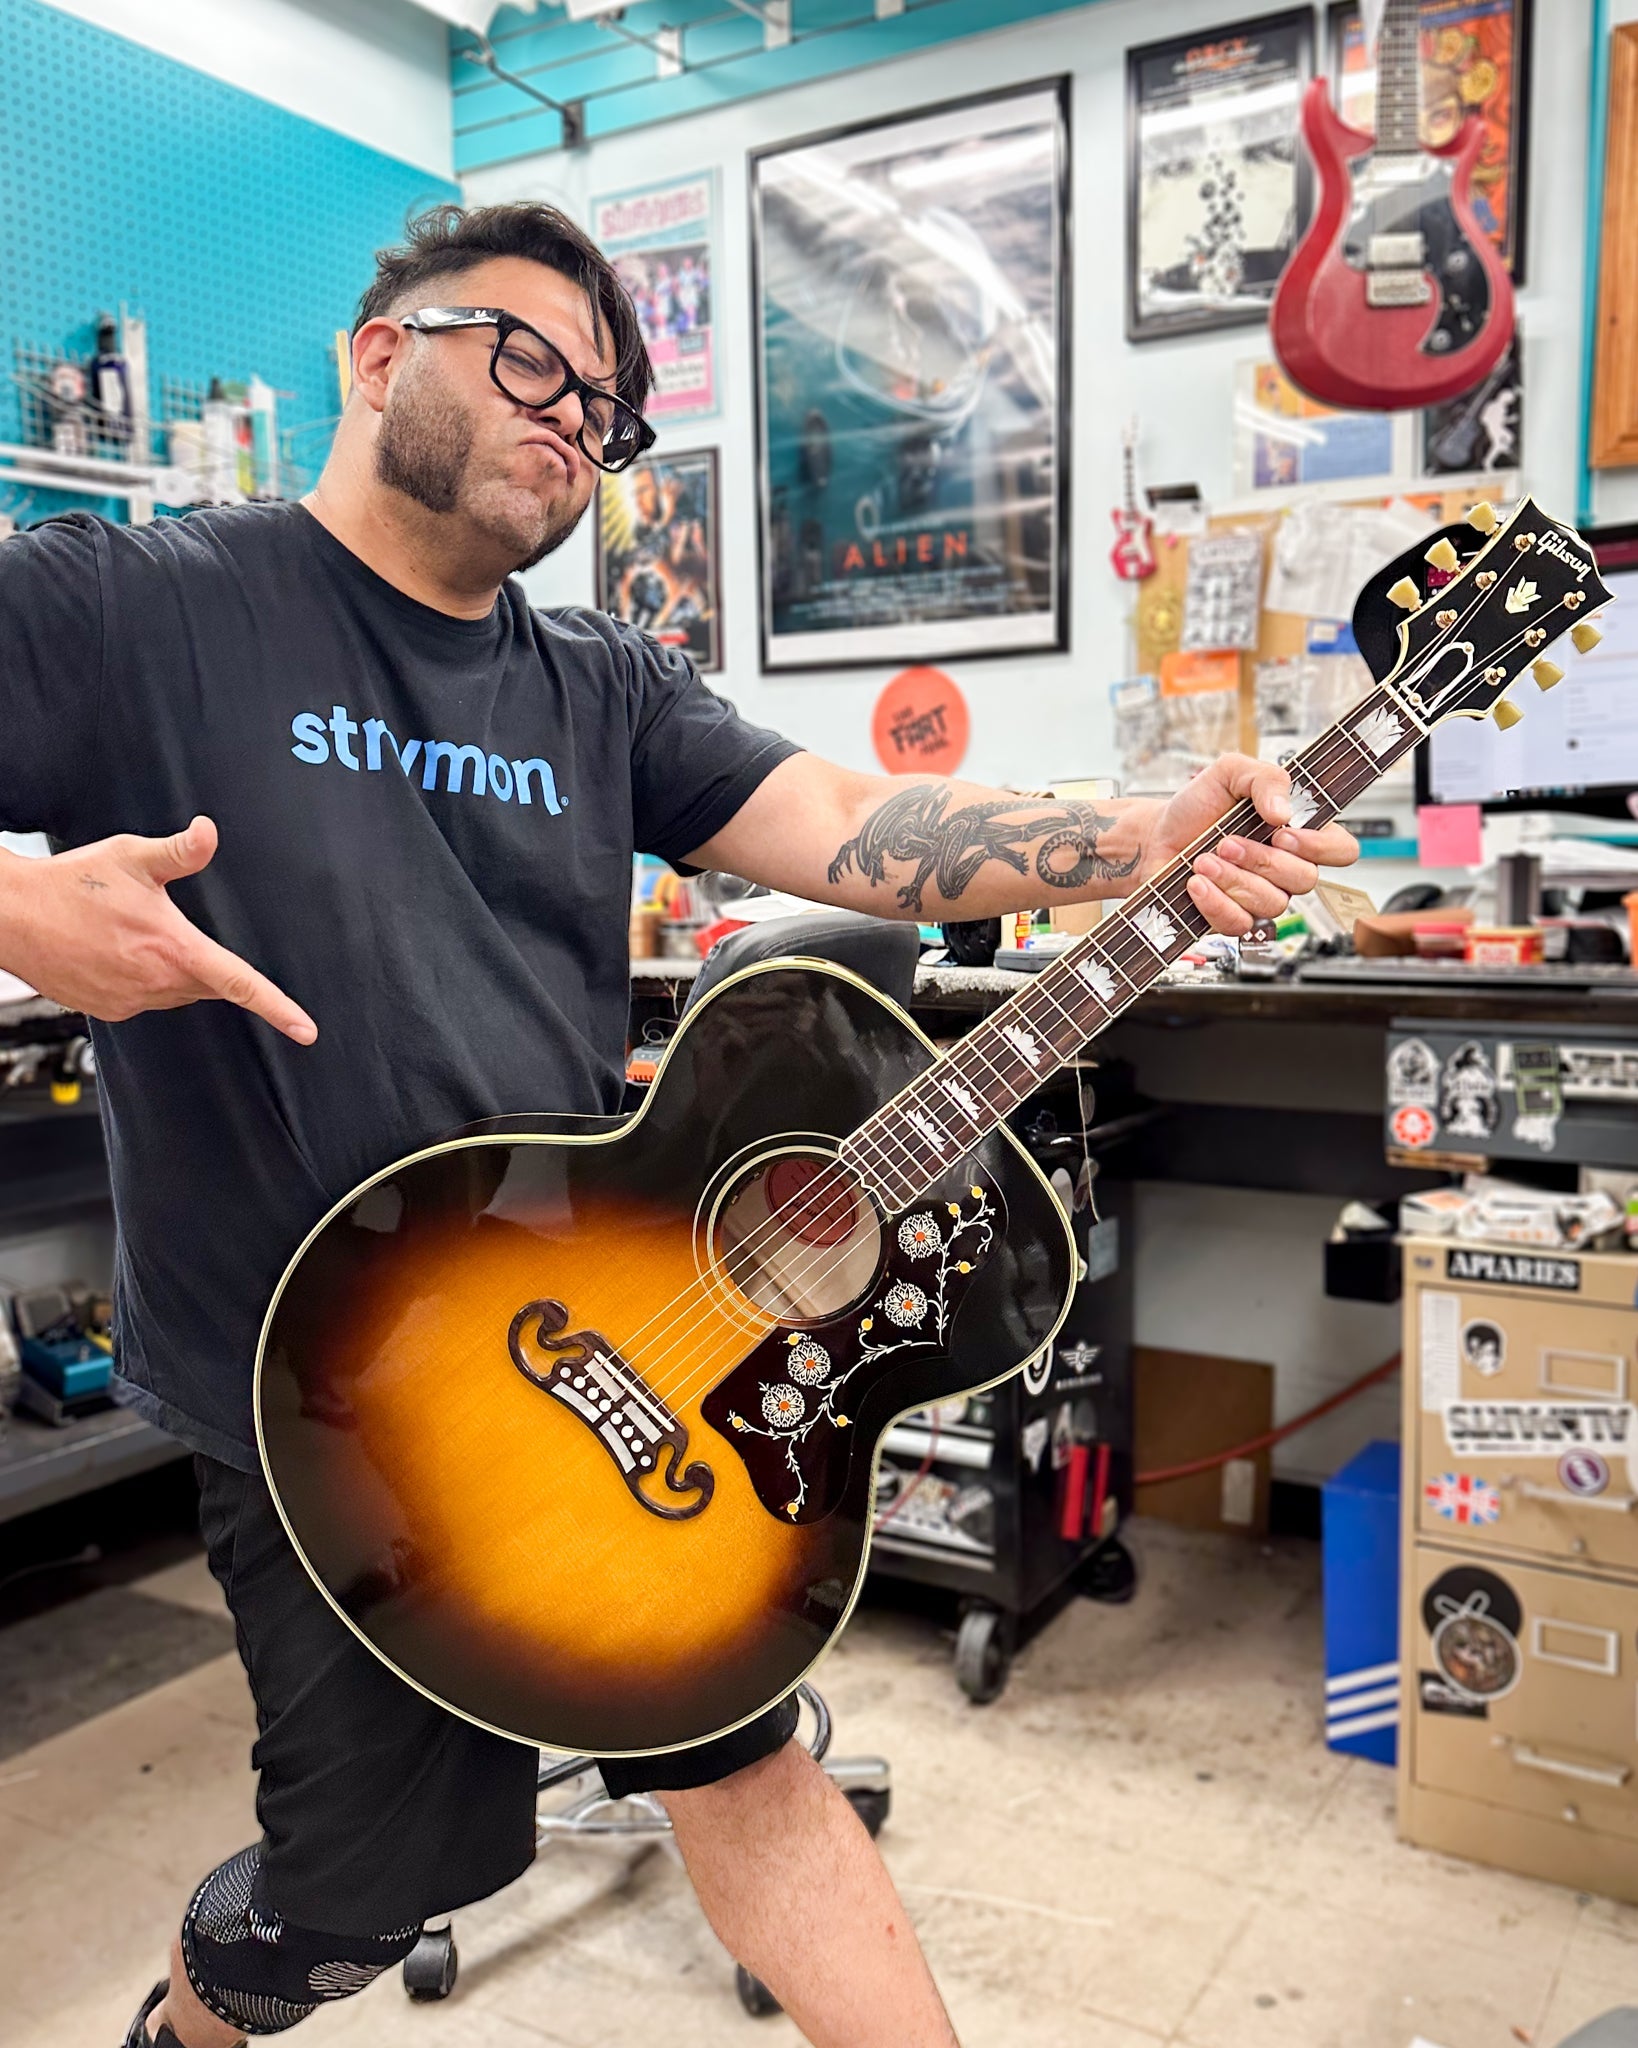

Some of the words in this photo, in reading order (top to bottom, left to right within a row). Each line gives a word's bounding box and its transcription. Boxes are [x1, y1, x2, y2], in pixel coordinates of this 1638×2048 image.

[843, 532, 967, 571] ALIEN
[1536, 530, 1592, 582] Gibson
[1450, 1252, 1577, 1288] APIARIES
